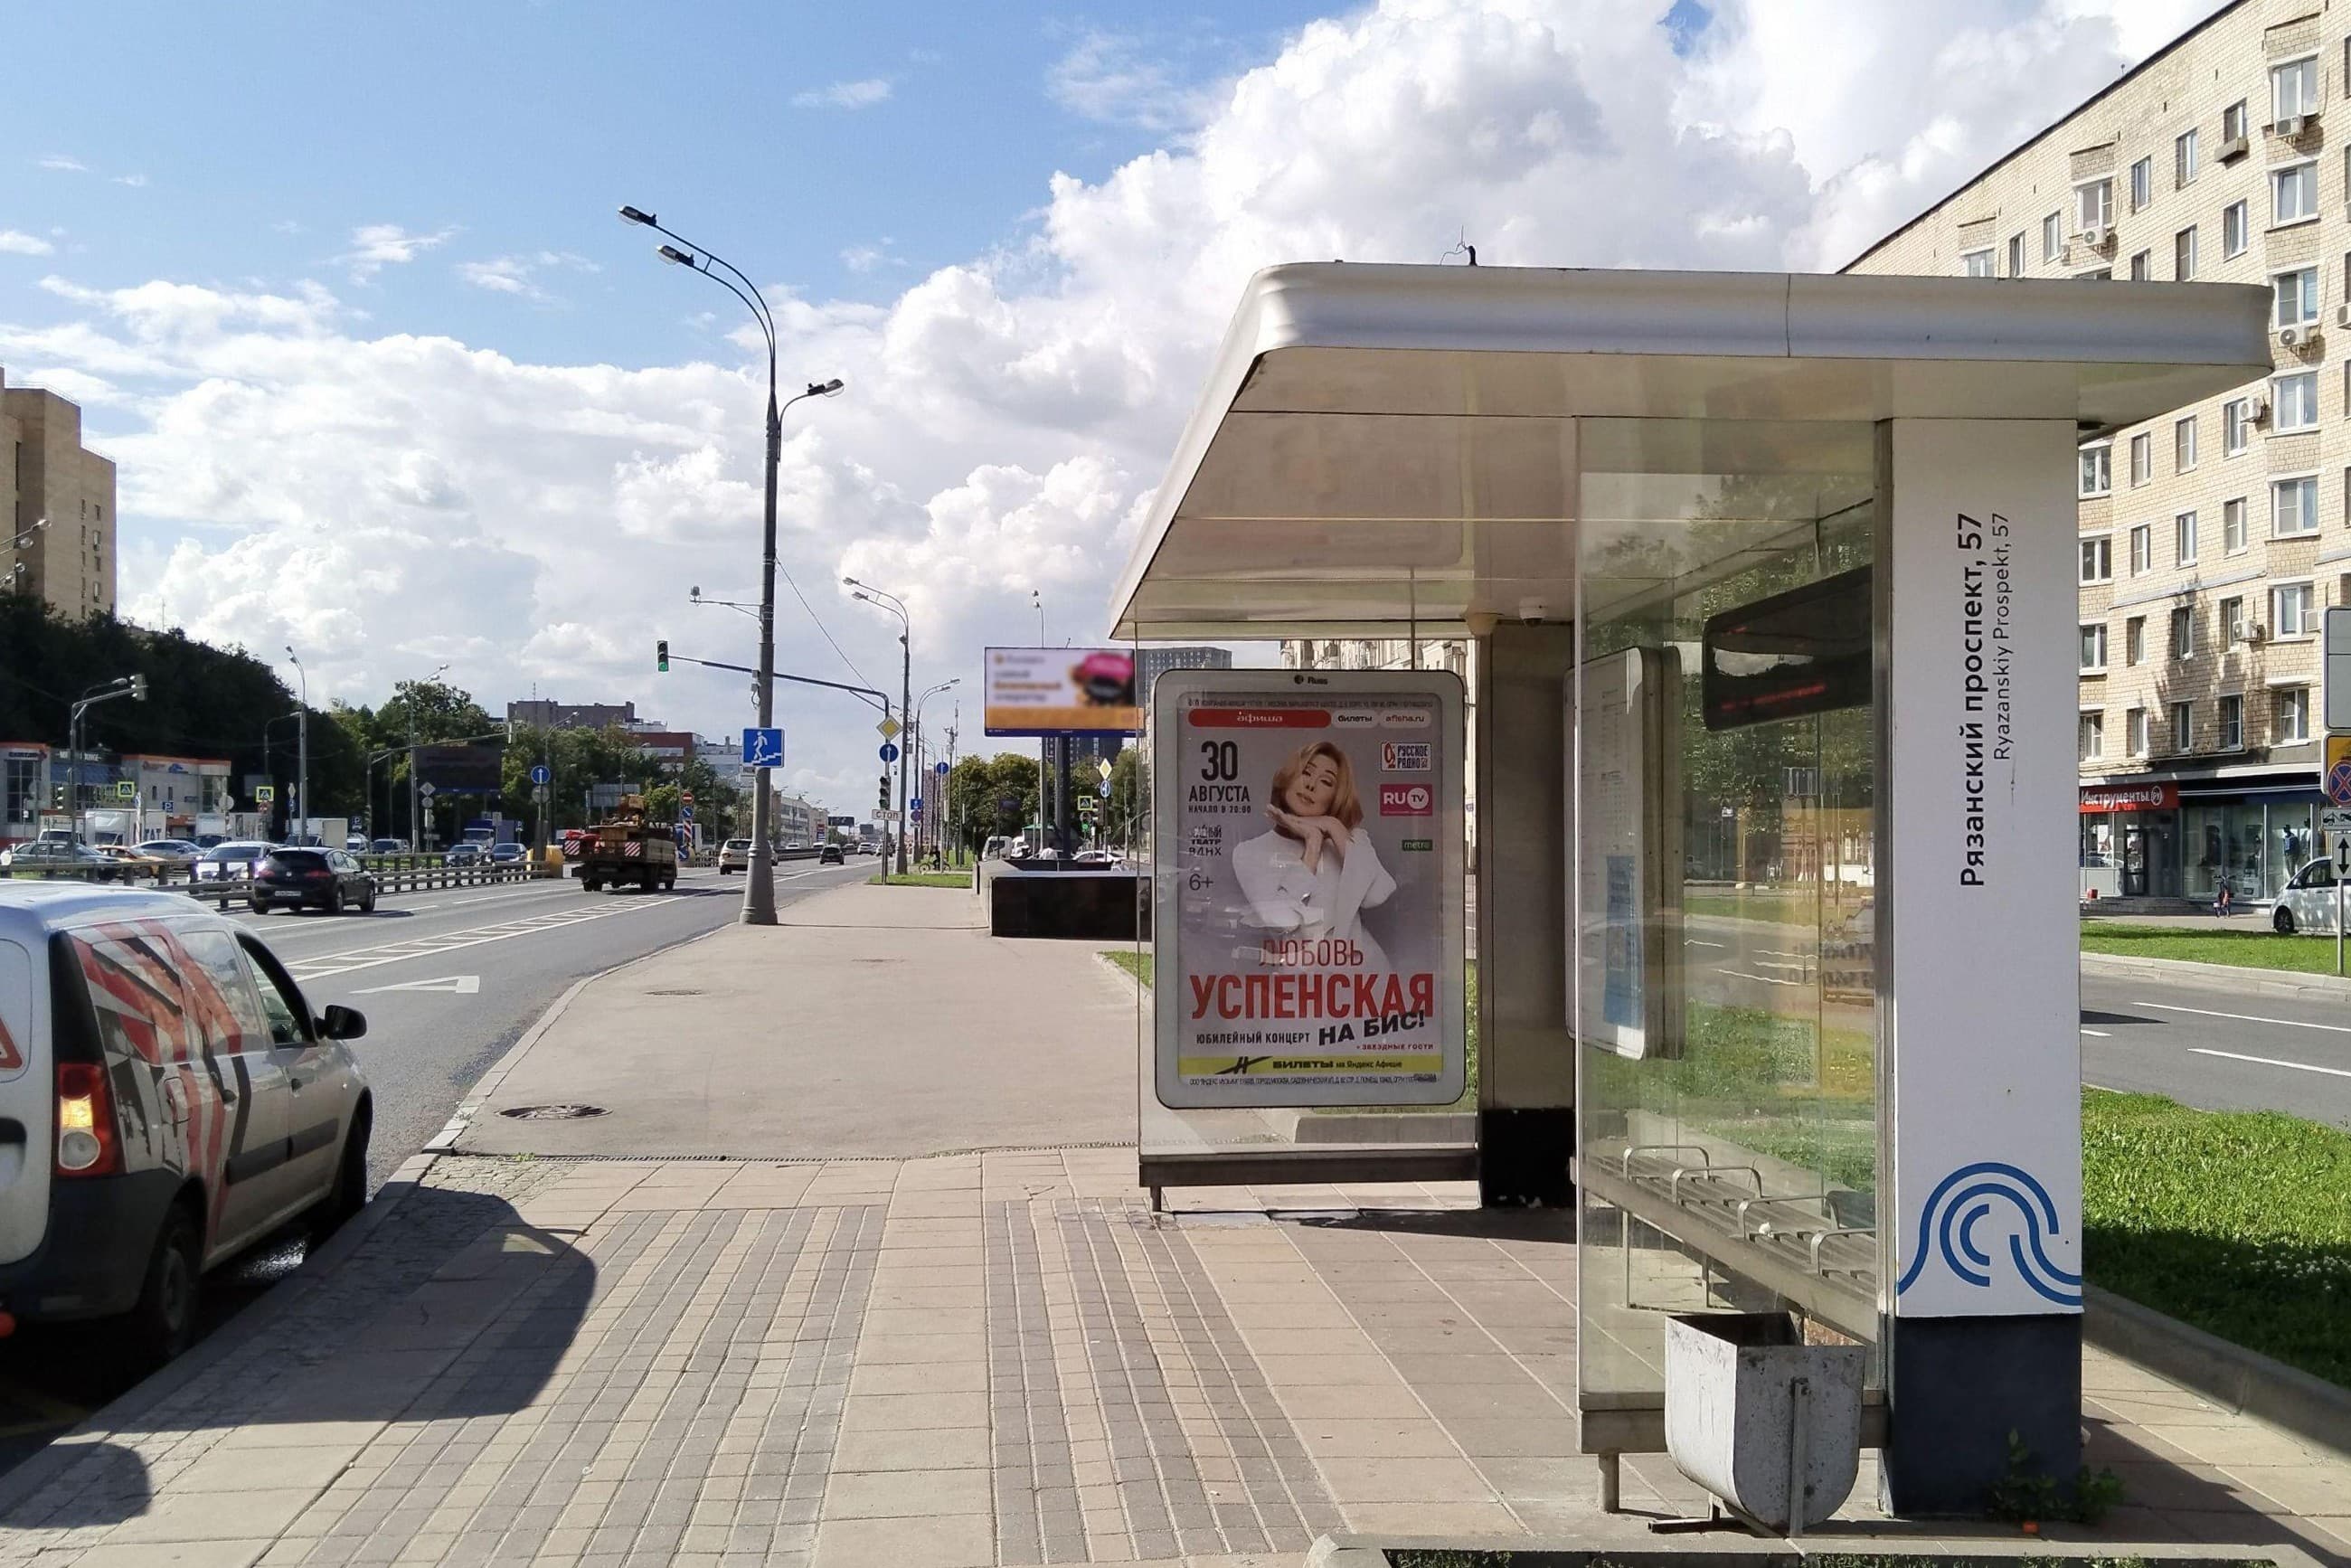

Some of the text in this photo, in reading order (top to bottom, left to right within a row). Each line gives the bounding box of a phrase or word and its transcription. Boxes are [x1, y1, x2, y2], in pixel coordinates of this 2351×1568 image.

[1992, 513, 2015, 760] Ryazanskiy Prospekt, 57
[1958, 513, 1988, 885] Рязанский проспект, 57
[1397, 745, 1429, 757] РУССКОЕ
[1201, 741, 1238, 781] 30
[1397, 758, 1421, 769] РАДИО
[1188, 786, 1251, 802] АВГУСТА
[1383, 792, 1424, 805] RU TV
[875, 811, 899, 819] СТОП
[1188, 806, 1218, 814] НАЧАЛО
[1189, 874, 1213, 891] 6+
[1259, 939, 1364, 967] ЛЮБОВЬ
[1189, 973, 1433, 1019] УСПЕНСКАЯ
[1318, 1010, 1425, 1046] НА БИС!
[1196, 1031, 1310, 1045] ЮБИЛЕЙНЫЙ КОНЦЕРТ
[1346, 1061, 1374, 1070] Яндекс
